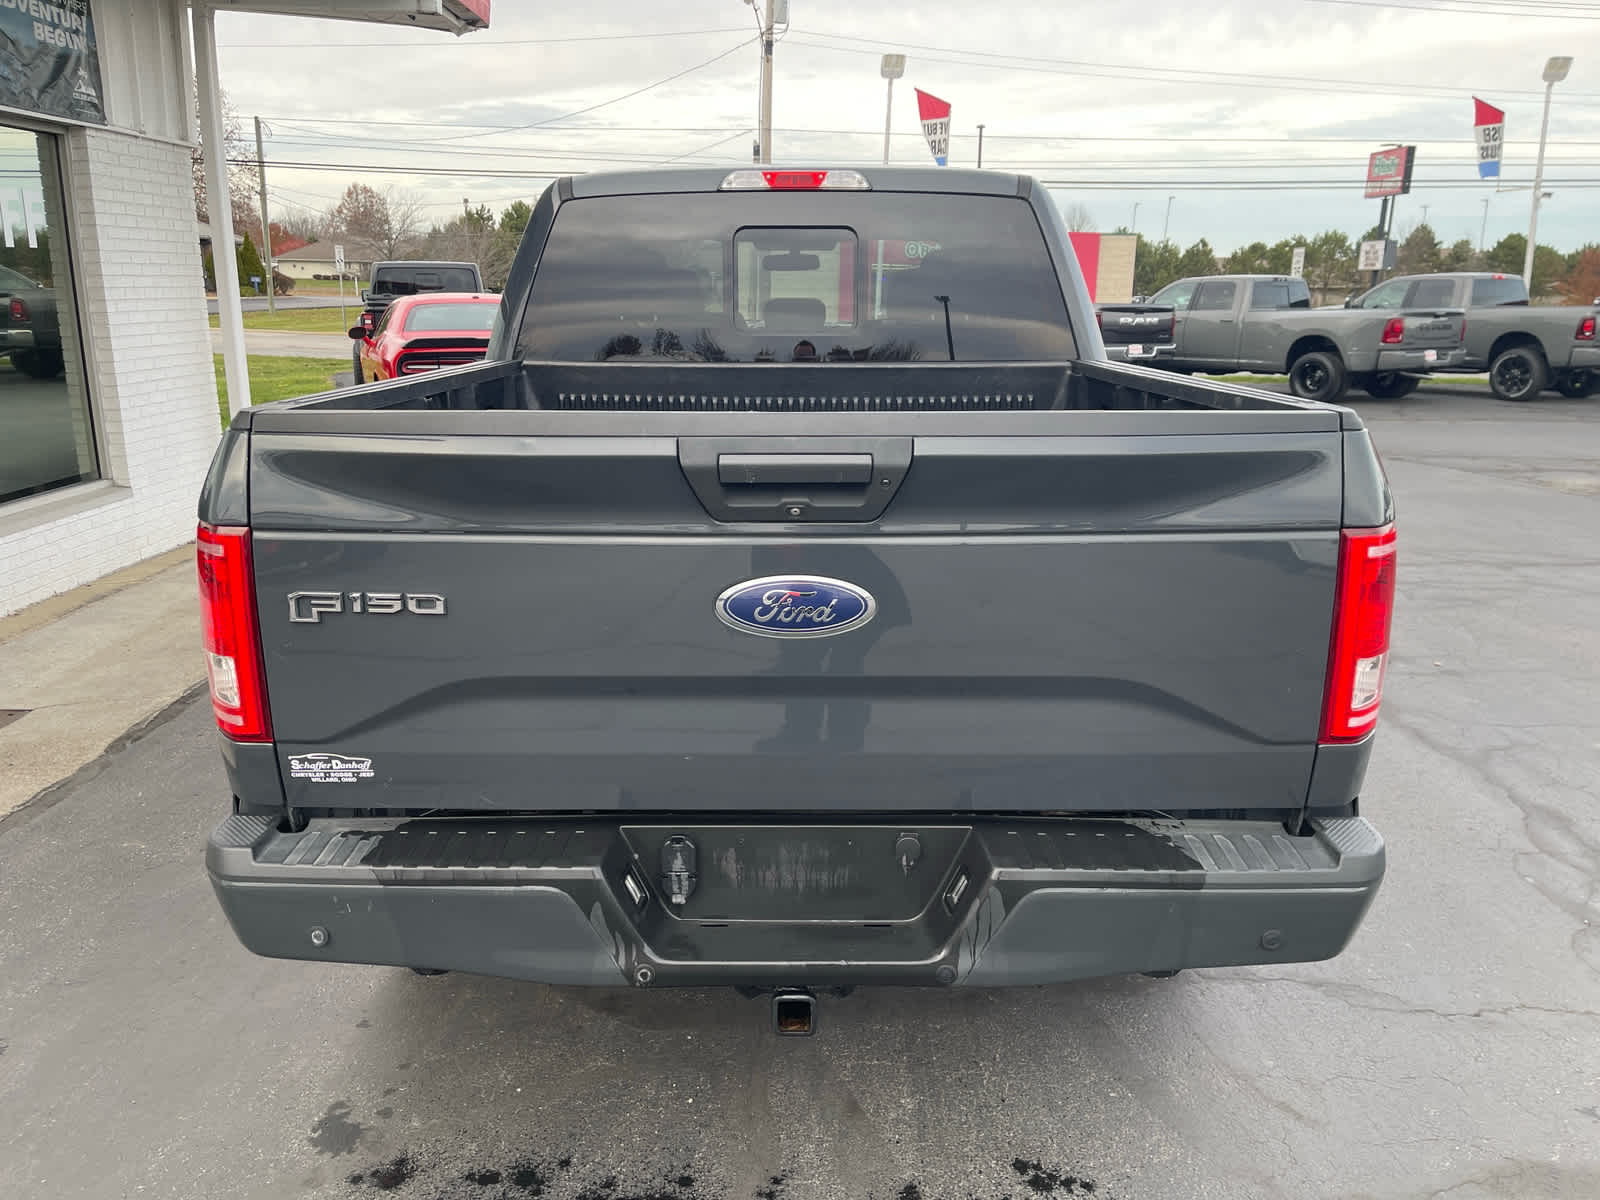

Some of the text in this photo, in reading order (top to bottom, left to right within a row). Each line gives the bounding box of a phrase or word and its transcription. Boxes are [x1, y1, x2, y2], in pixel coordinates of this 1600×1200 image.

[1119, 317, 1160, 327] RAM
[753, 589, 837, 623] Ford
[290, 759, 371, 772] Schaffer Danhoff
